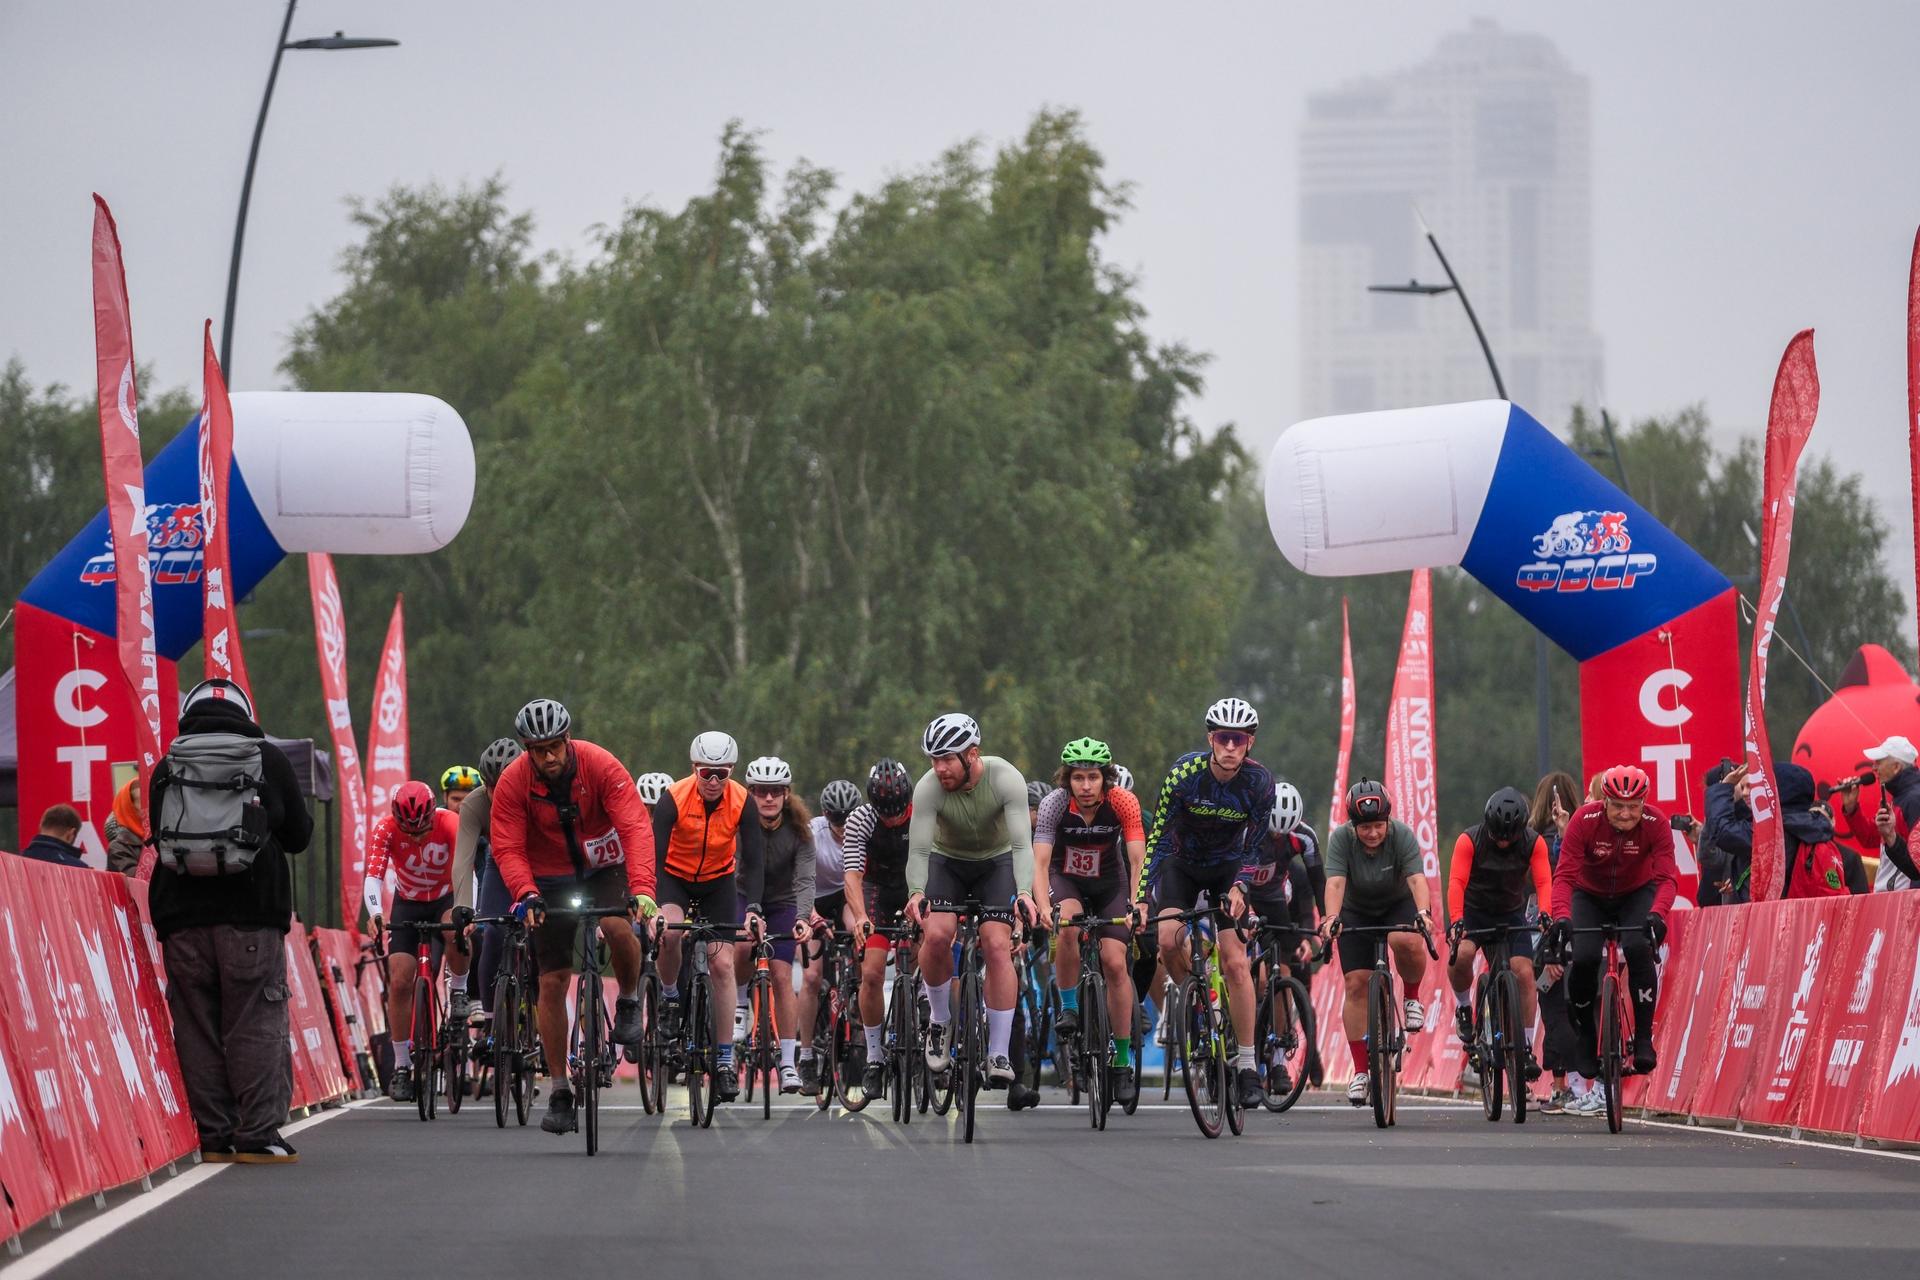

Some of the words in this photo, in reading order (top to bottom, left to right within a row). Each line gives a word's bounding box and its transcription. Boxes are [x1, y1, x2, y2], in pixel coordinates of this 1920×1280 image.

[1516, 553, 1657, 592] ФВСР
[593, 839, 621, 864] 29
[1072, 852, 1093, 871] 33
